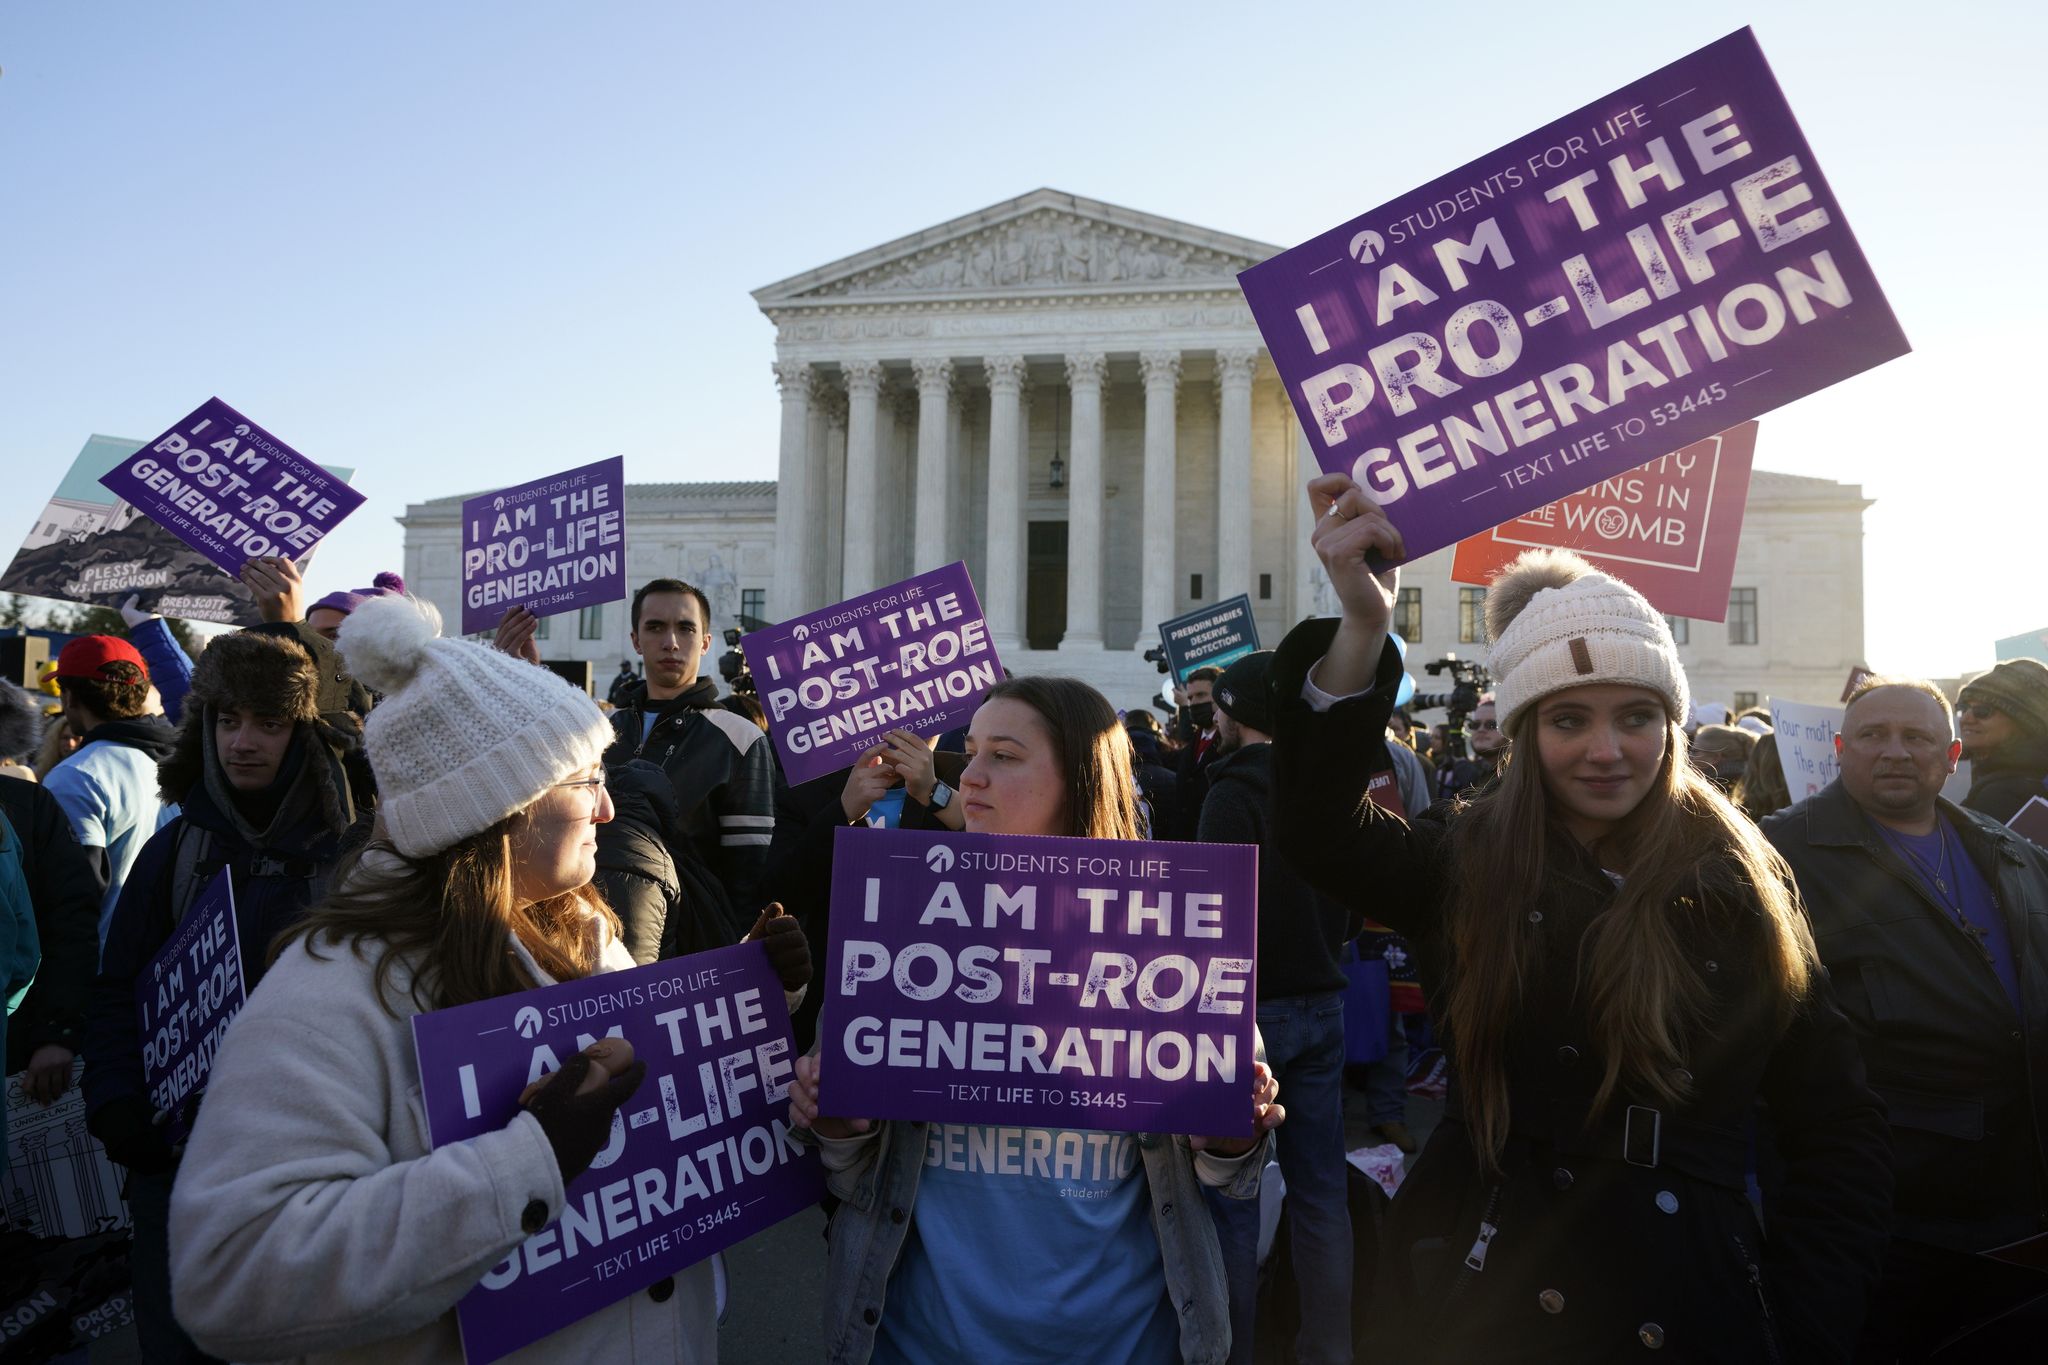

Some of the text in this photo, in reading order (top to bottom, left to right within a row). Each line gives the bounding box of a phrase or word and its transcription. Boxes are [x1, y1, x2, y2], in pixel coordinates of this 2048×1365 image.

[1388, 104, 1653, 245] STUDENTS FOR LIFE
[1295, 104, 1753, 355] I AM THE
[1300, 154, 1831, 448] PRO-LIFE
[1351, 249, 1854, 506] GENERATION
[247, 433, 329, 490] STUDENTS FOR LIFE
[1500, 454, 1555, 491] TEXT
[1559, 431, 1611, 467] LIFE
[1611, 417, 1647, 445] TO
[1650, 384, 1729, 428] 53445
[153, 432, 325, 550] POST-ROE
[190, 418, 337, 520] I AM THE
[505, 474, 587, 507] STUDENTS FOR LIFE
[1575, 477, 1690, 511] INS IN
[155, 502, 226, 553] TEXT LIFE TO 53445
[472, 483, 609, 543] I AM THE
[1522, 502, 1686, 546] HE WOMB
[84, 562, 143, 581] PLESSY
[465, 510, 620, 581] PRO-LIFE
[93, 571, 167, 593] FERGUSON
[161, 597, 228, 610] DRED SCOTT
[467, 551, 617, 609] GENERATION
[524, 600, 539, 610] LIFE
[540, 597, 550, 606] TO
[551, 591, 575, 603] 53445
[810, 586, 925, 633] STUDENTS FOR LIFE
[766, 592, 963, 681] I AM THE
[1170, 607, 1243, 640] PREBORN BABIES
[1190, 625, 1229, 646] DESERVE
[767, 618, 988, 723] POST-ROE
[786, 659, 998, 754] GENERATION
[851, 737, 875, 751] TEXT
[915, 711, 947, 729] 53445
[1806, 720, 1835, 742] moth
[1794, 745, 1814, 774] the
[960, 852, 1171, 879] STUDENTS FOR LIFE
[863, 877, 1224, 939] I AM THE
[143, 909, 227, 1032] I AM THE
[547, 968, 720, 1027] STUDENTS FOR LIFE
[840, 940, 1253, 1015] POST-ROE
[143, 944, 239, 1085] POST-ROE
[150, 1001, 240, 1112] GENERATI
[458, 1063, 482, 1120] I
[655, 987, 768, 1056] THE
[843, 1016, 1237, 1084] GENERATION
[589, 1037, 797, 1169] -LIFE
[948, 1084, 1127, 1109] TEXT LIFE TO 53445
[924, 1122, 1138, 1181] GENERATIO
[593, 1201, 741, 1282] TEXT LIFE TO 53445
[76, 1298, 127, 1331] DRED
